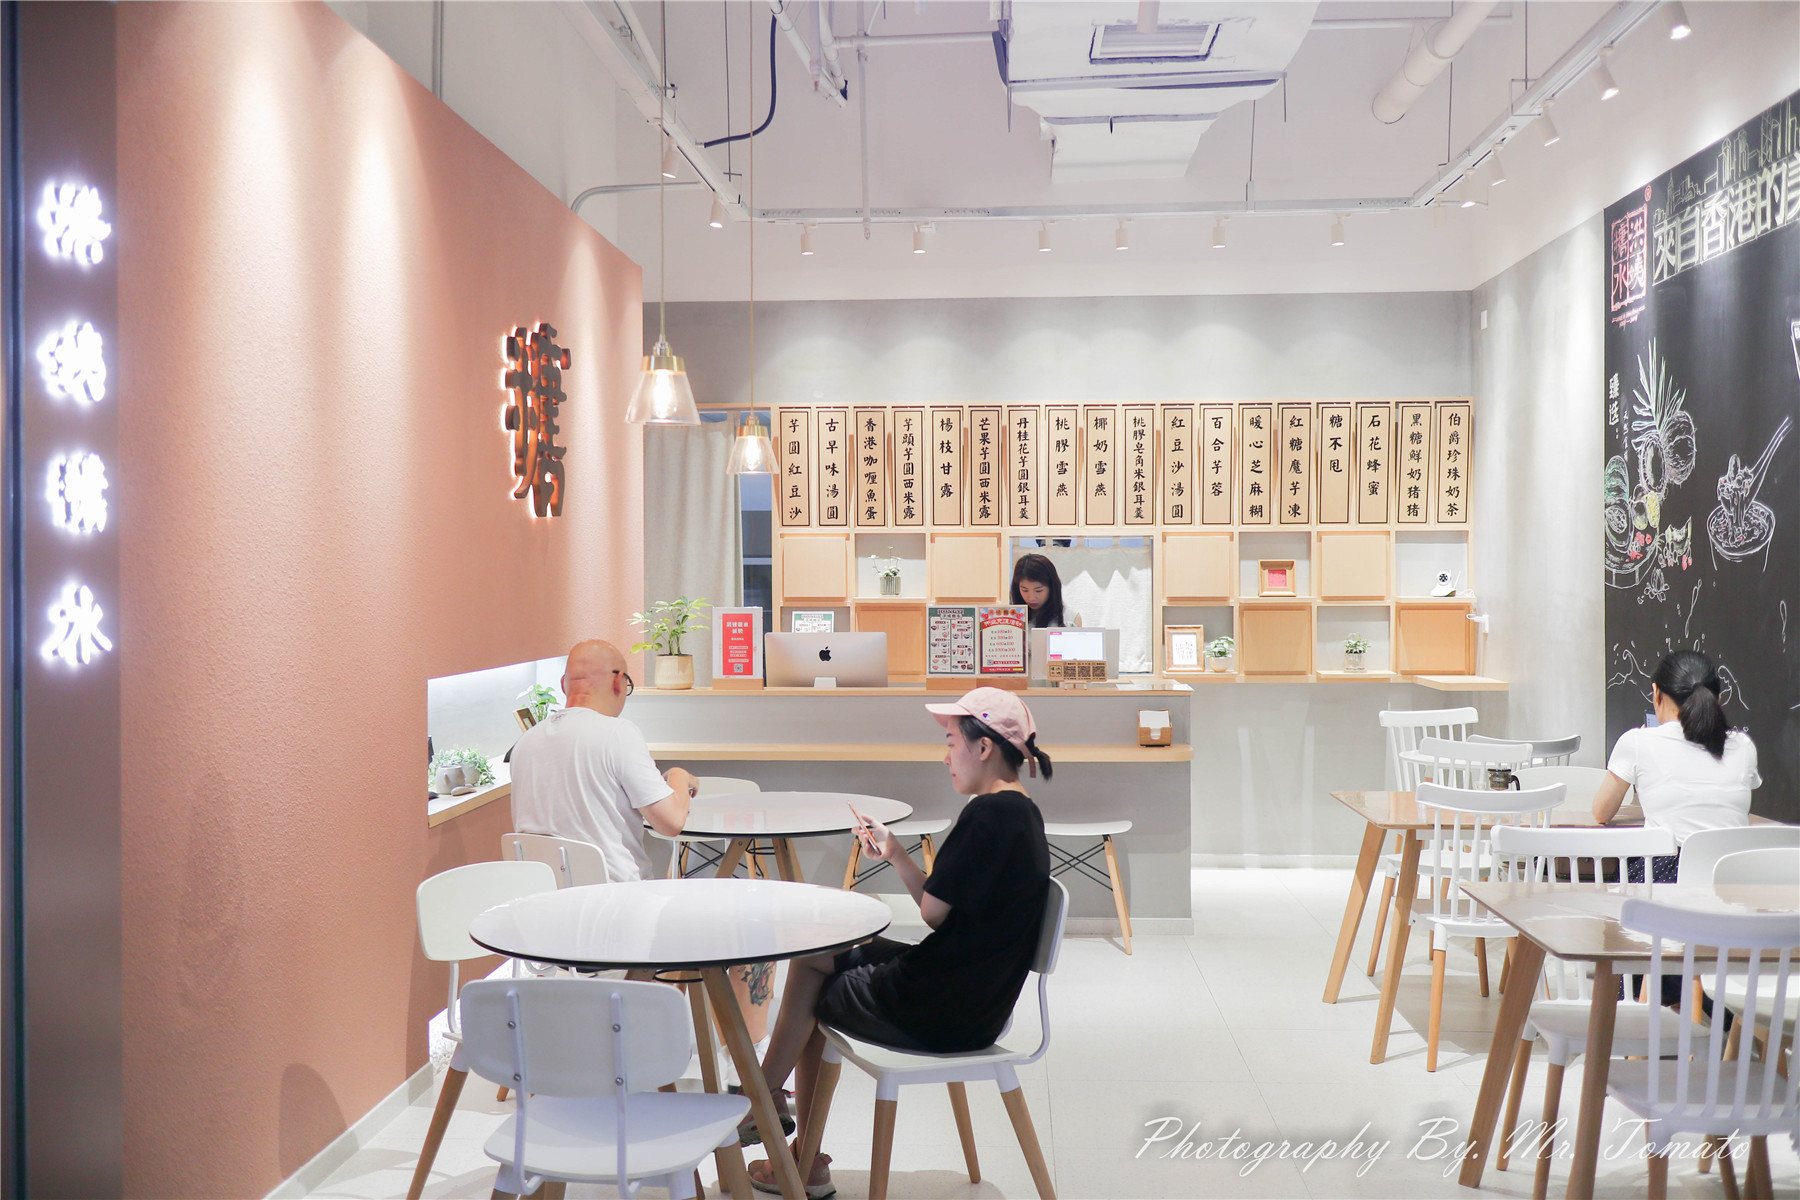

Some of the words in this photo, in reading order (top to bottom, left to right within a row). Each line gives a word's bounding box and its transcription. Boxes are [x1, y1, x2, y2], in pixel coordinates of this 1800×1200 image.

[787, 417, 803, 520] 芋圓紅豆沙
[825, 418, 839, 520] 古早味湯圓
[863, 417, 878, 521] 香港咖喱魚蛋
[901, 417, 917, 520] 芋頭芋圓西米露
[939, 417, 954, 498] 楊枝甘露
[978, 417, 992, 519] 芒果芋圓西米露
[1055, 416, 1070, 497] 桃膠雪燕
[1092, 416, 1109, 498] 椰奶雪燕
[1170, 415, 1187, 519] 紅豆沙湯圓
[1210, 416, 1226, 498] 百合芋蓉
[1248, 414, 1264, 518] 暖心芝麻糊
[1287, 415, 1304, 518] 紅糖魔芋凍
[1328, 413, 1344, 474] 糖不甩
[1366, 414, 1382, 496] 石花蜂蜜
[1445, 412, 1461, 517] 伯爵珍珠奶茶
